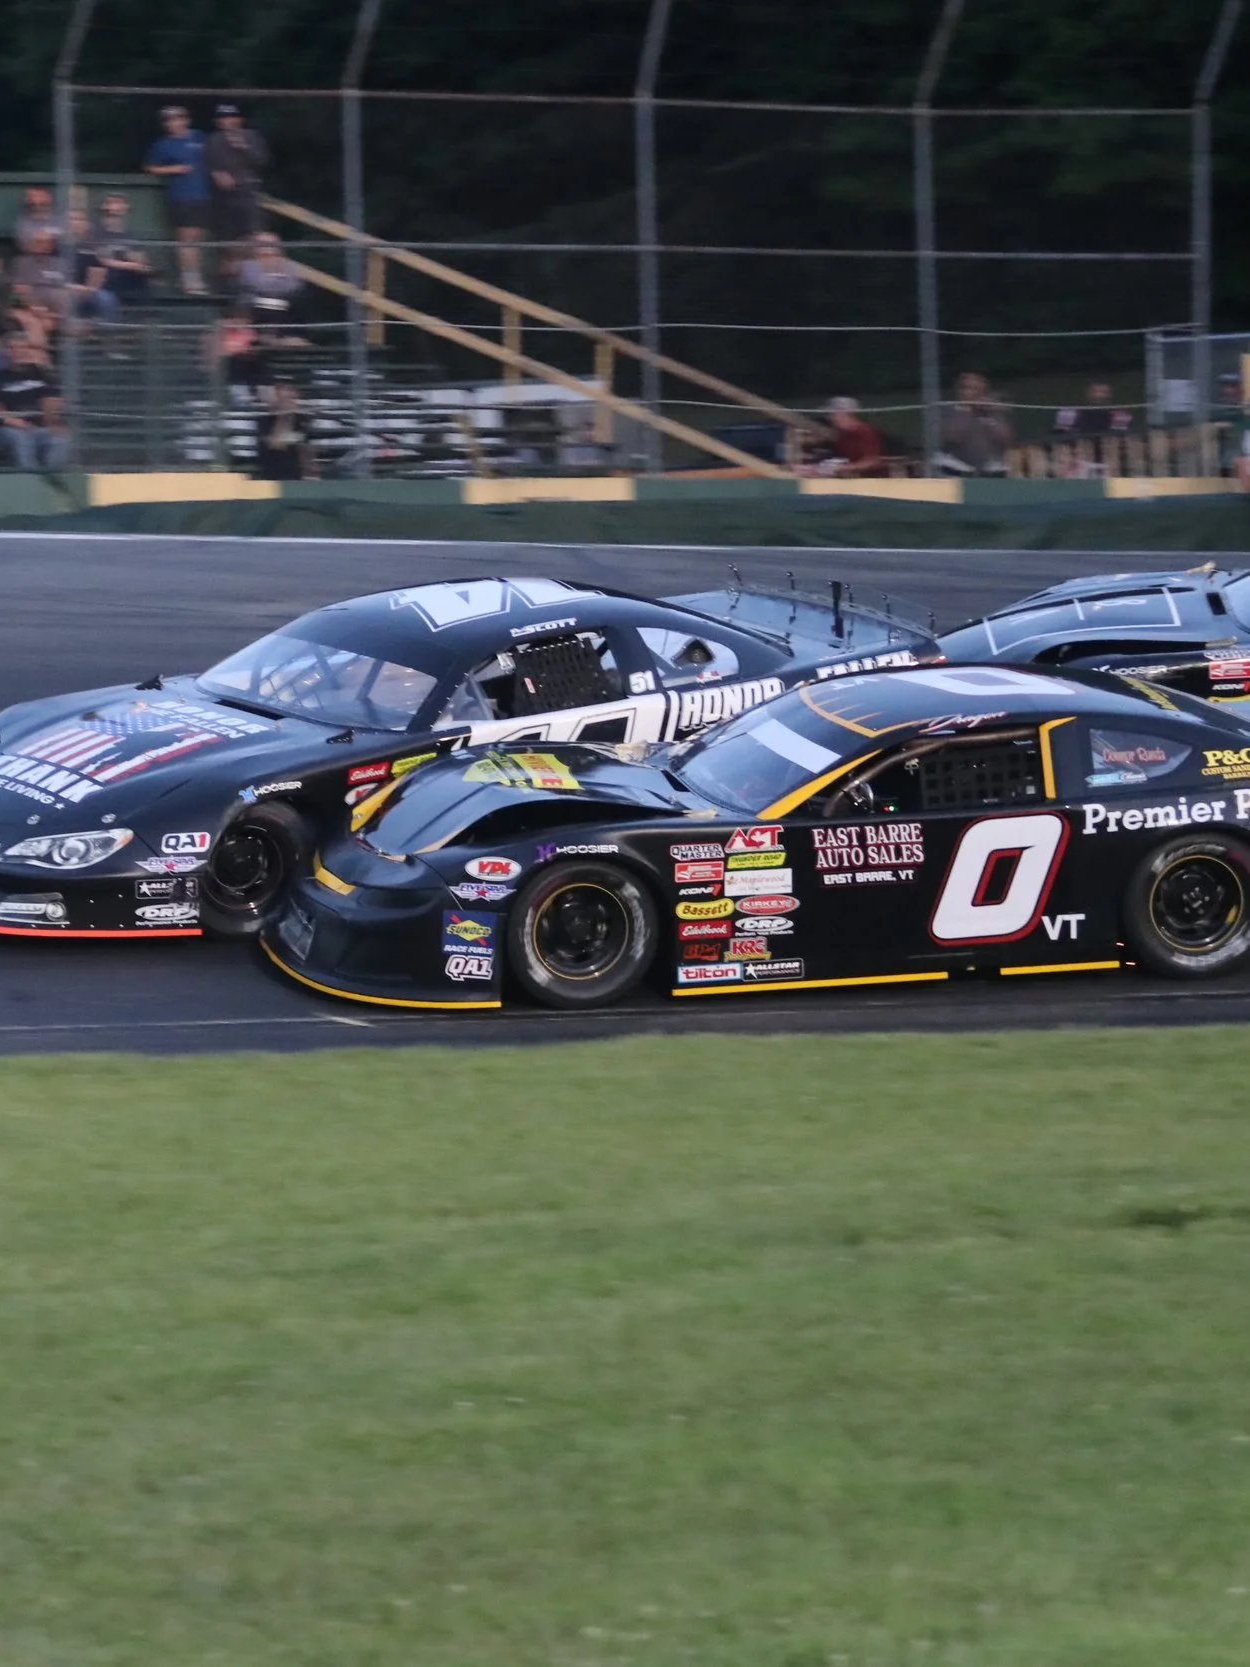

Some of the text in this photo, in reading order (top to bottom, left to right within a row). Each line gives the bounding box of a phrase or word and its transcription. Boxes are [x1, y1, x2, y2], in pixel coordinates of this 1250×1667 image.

[629, 670, 656, 693] 51
[4, 782, 55, 804] LIVING
[254, 781, 303, 796] HOOSIER
[1082, 797, 1226, 835] Premier
[165, 834, 207, 851] QA1
[727, 826, 784, 848] ACT
[812, 823, 923, 847] EAST BARRE
[556, 844, 619, 854] HOOSIER
[672, 844, 720, 856] QUARTER
[681, 852, 722, 860] MASTER
[816, 844, 925, 868] AUTO SALES
[823, 870, 914, 885] EAST BARRE, VT
[927, 810, 1071, 946] 0
[679, 886, 714, 896] KONI
[682, 903, 728, 915] Bassett
[449, 925, 491, 935] SUNOCO
[682, 924, 727, 936] Edelbrock
[744, 919, 786, 929] DRP
[1042, 913, 1086, 941] VT
[444, 944, 493, 954] RACE FUELS
[732, 940, 764, 954] KRC
[449, 956, 491, 978] QA1
[683, 966, 737, 979] tilton
